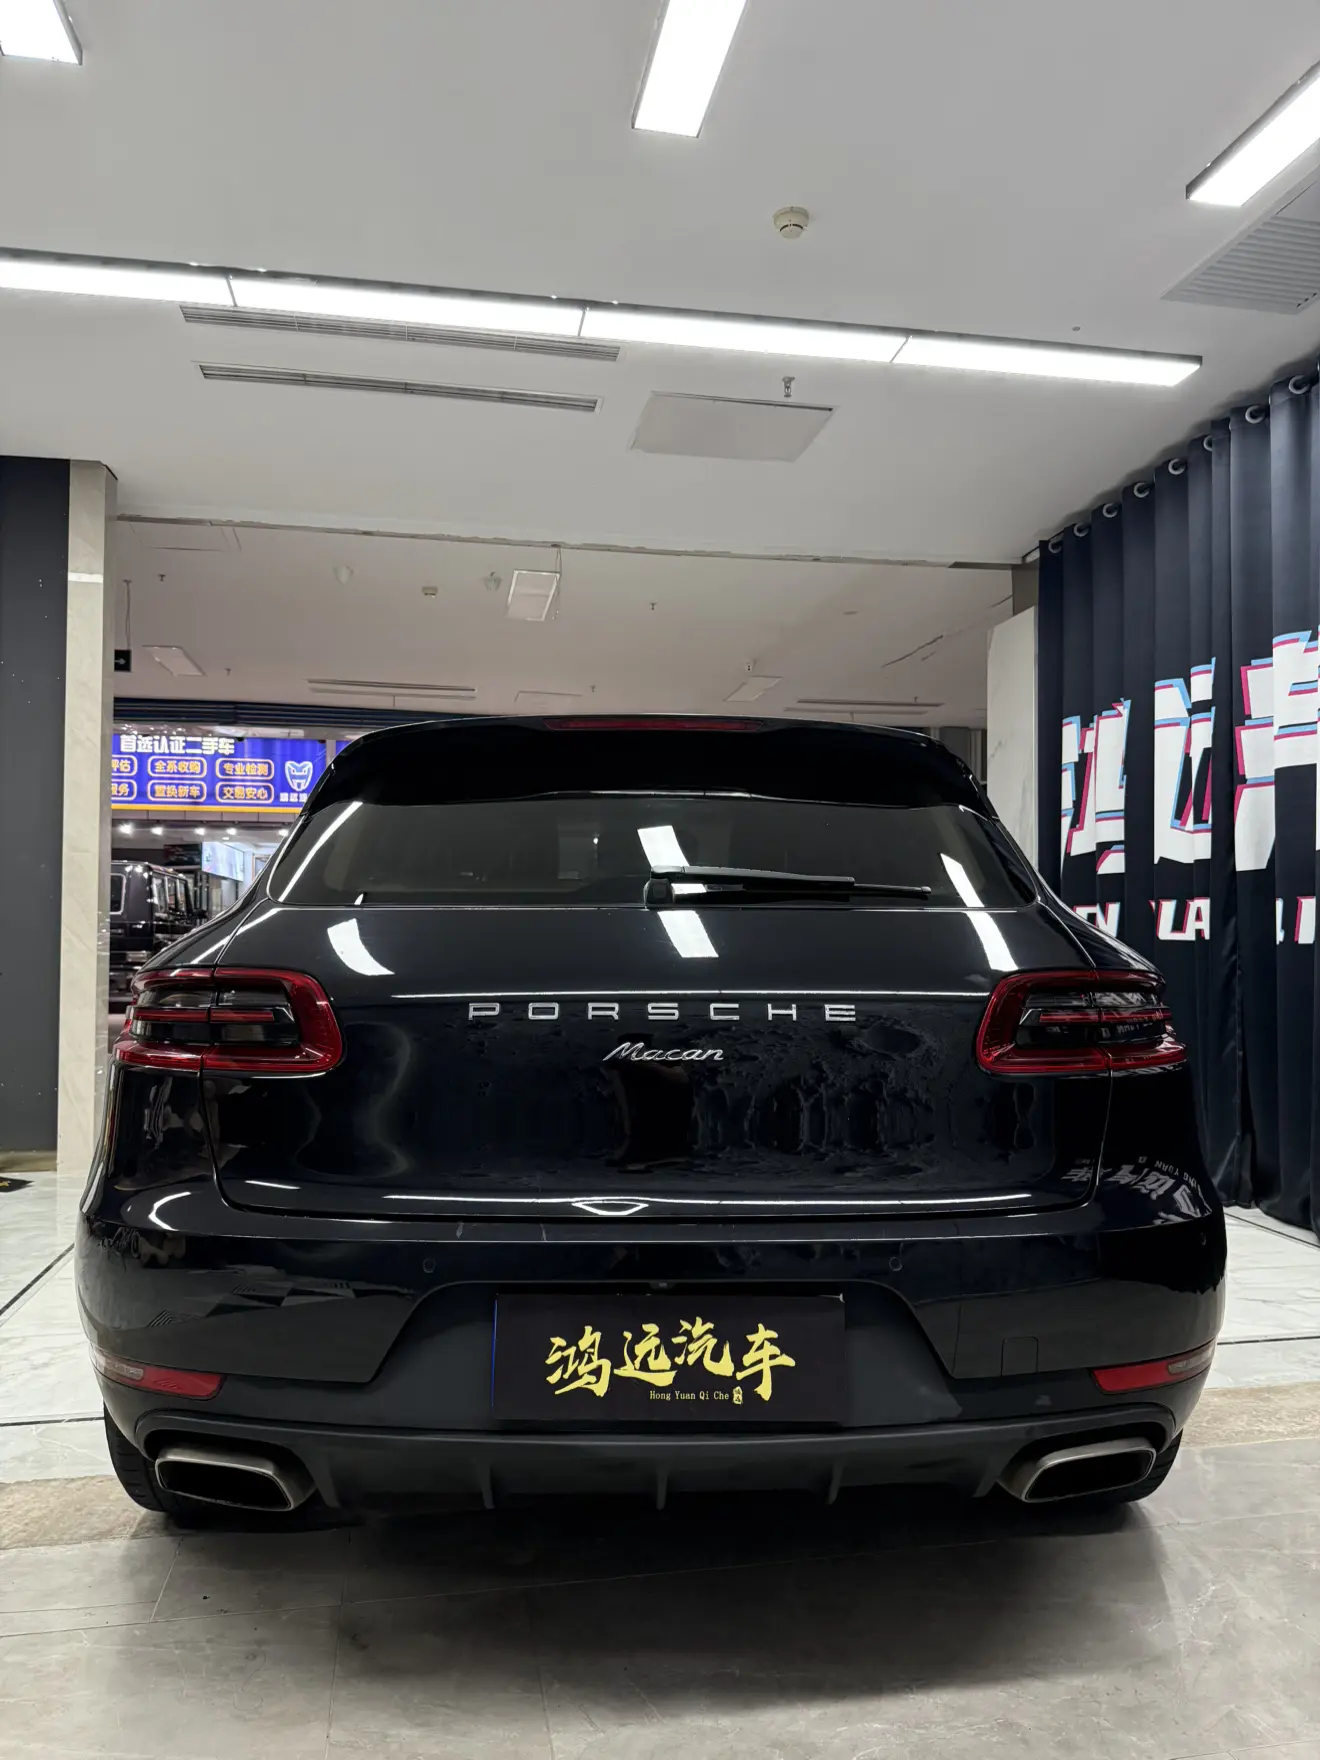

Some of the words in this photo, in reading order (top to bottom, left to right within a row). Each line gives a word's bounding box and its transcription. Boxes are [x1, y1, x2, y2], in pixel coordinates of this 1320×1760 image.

[120, 735, 235, 755] 首选认证二手车
[154, 760, 201, 773] 全系收购
[223, 763, 269, 775] 专业检测
[154, 785, 201, 798] 置换新车
[223, 787, 269, 799] 交易安心
[468, 1003, 856, 1021] PORSCHE
[603, 1042, 724, 1062] Macan
[545, 1316, 796, 1401] 鸿远汽车
[650, 1390, 671, 1400] Hong
[675, 1390, 696, 1400] Yuan
[700, 1390, 709, 1400] Qi
[713, 1390, 729, 1400] Che
